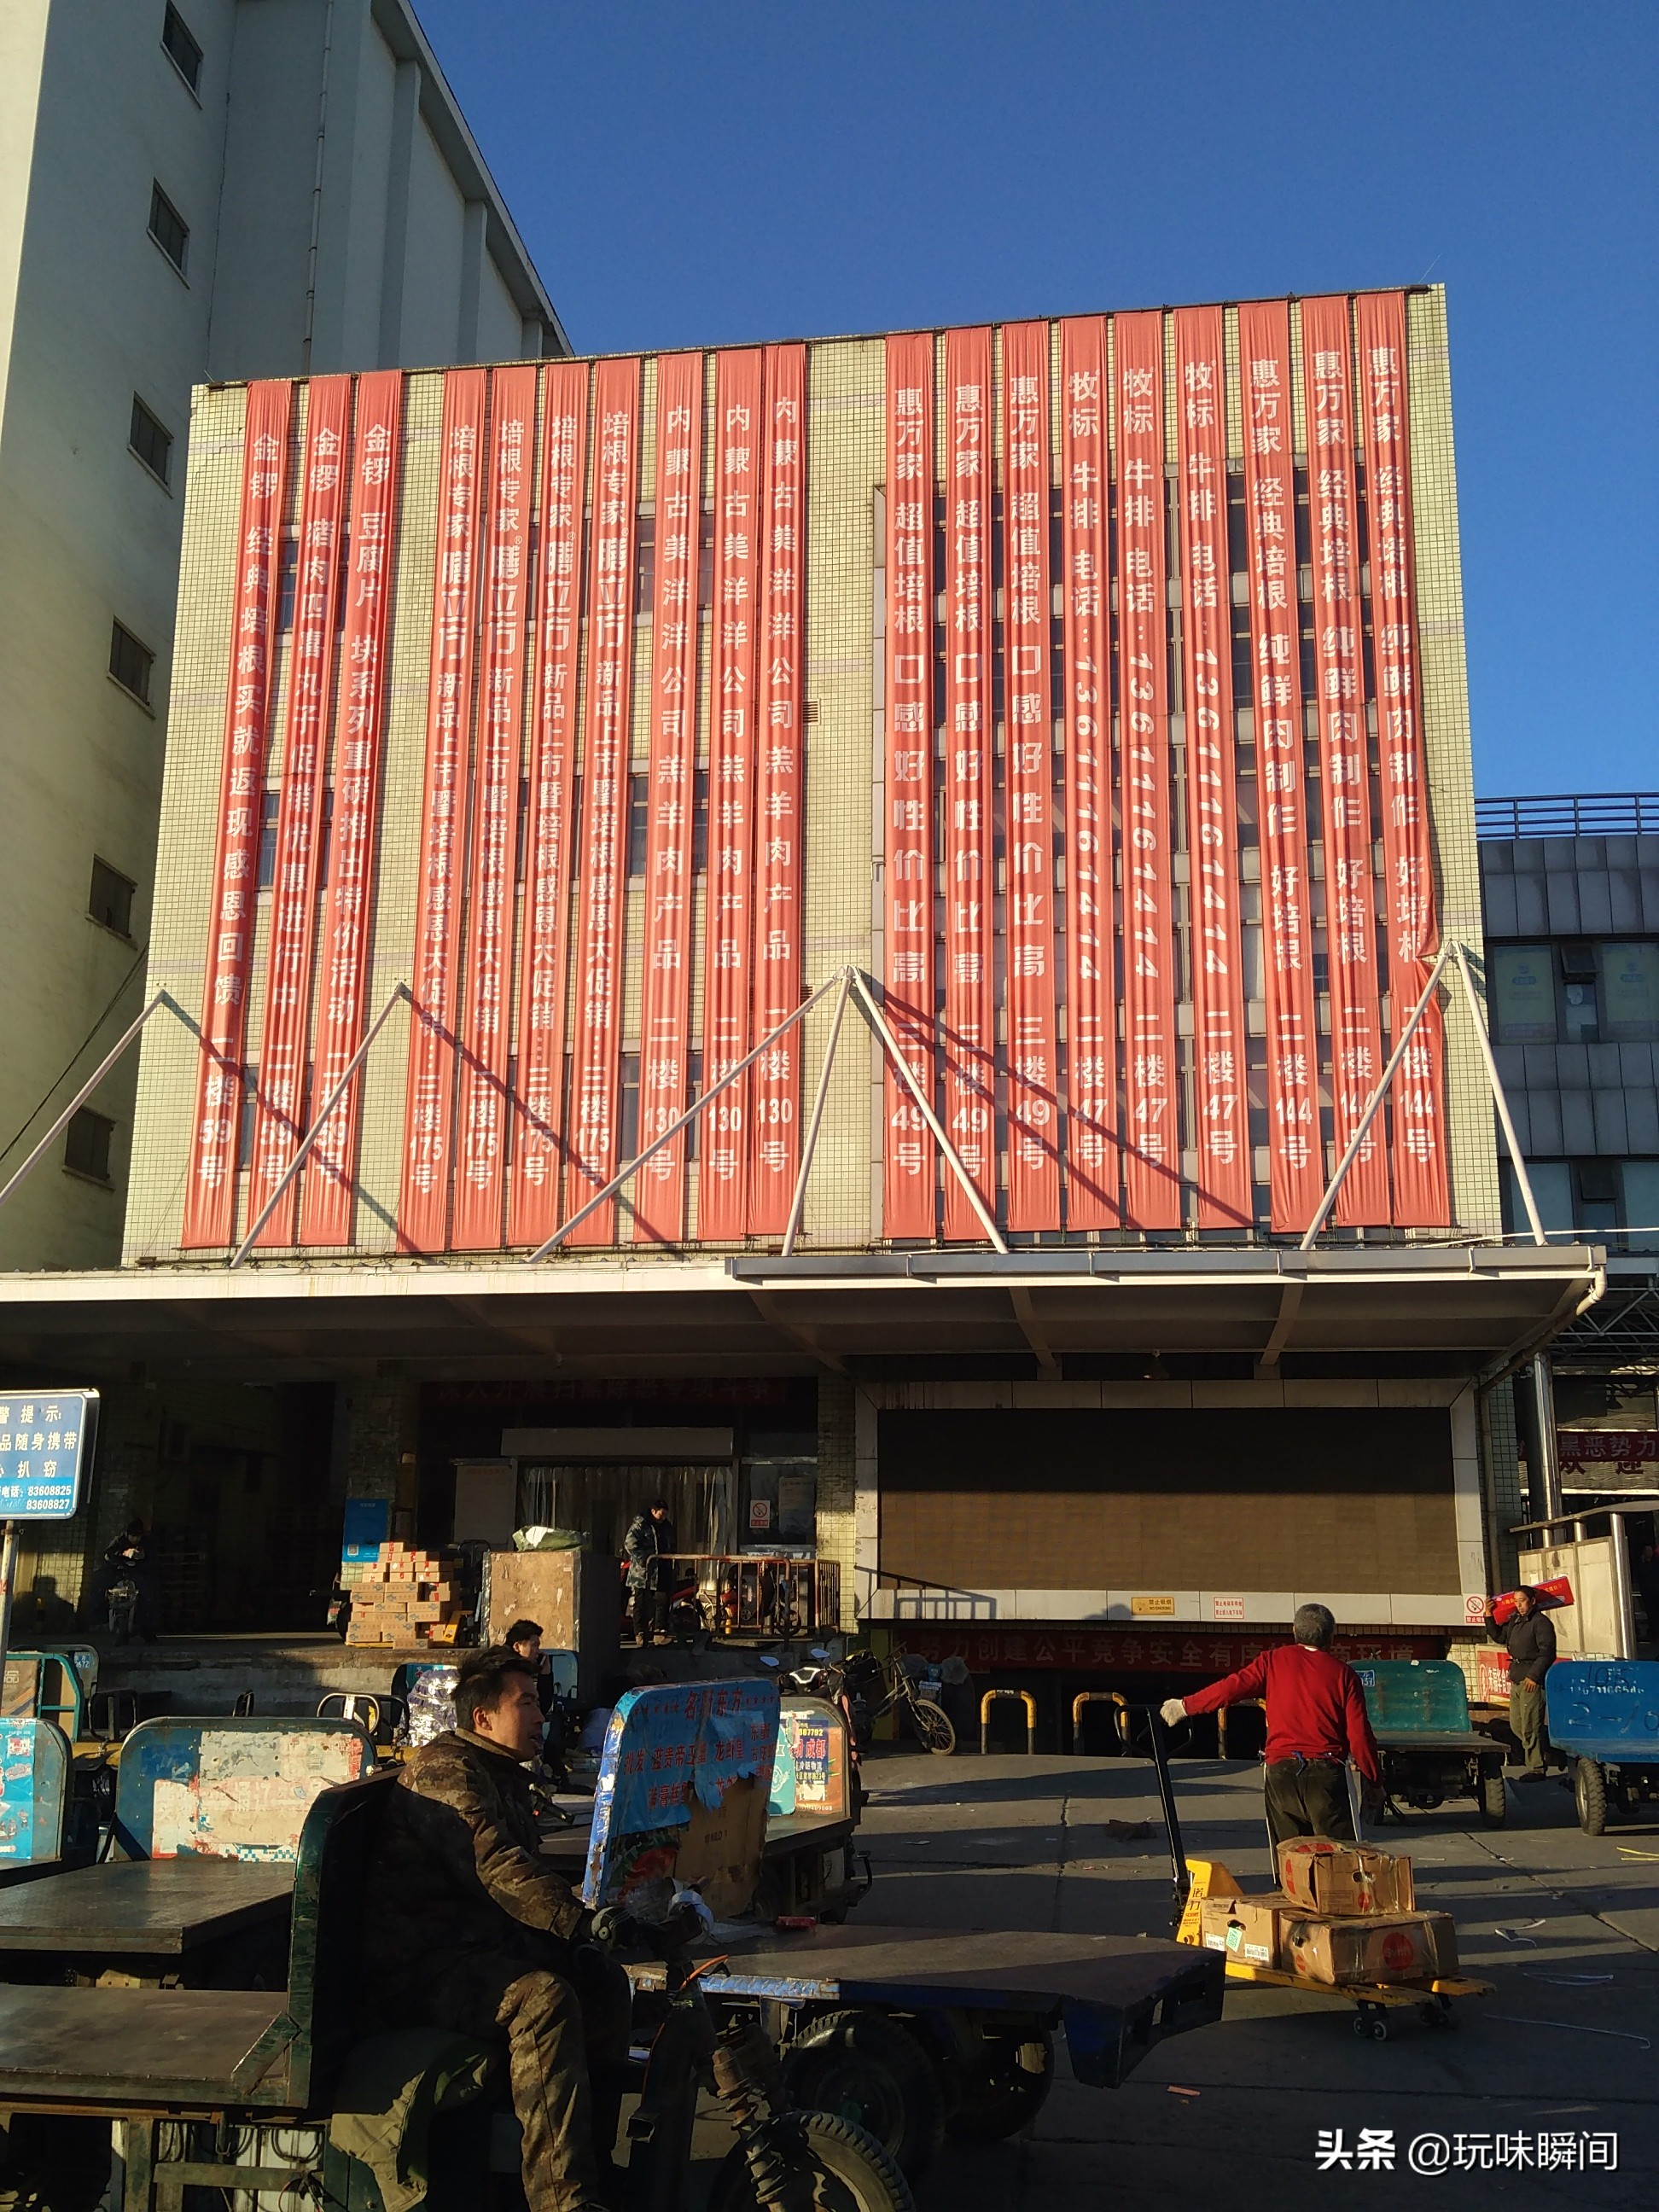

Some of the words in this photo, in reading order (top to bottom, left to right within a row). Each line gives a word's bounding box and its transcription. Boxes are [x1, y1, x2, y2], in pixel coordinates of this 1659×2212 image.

[894, 387, 924, 480] 惠万家
[955, 384, 983, 479] 惠万家
[1010, 375, 1039, 470] 惠万家
[1249, 358, 1282, 455] 惠万家
[1312, 350, 1346, 446] 惠万家
[1367, 346, 1400, 444] 惠万家
[249, 433, 280, 500] 金锣
[310, 427, 341, 493] 金锣
[360, 423, 392, 486] 金锣
[197, 1037, 235, 1189] 二楼59号
[1074, 1016, 1109, 1168] 二楼47号
[1133, 1014, 1167, 1167] 二楼47号
[1203, 1010, 1238, 1165] 二楼47号
[0, 1431, 77, 1451] 品随身携带
[26, 1499, 70, 1510] 83608827
[806, 1738, 826, 1759] 成都
